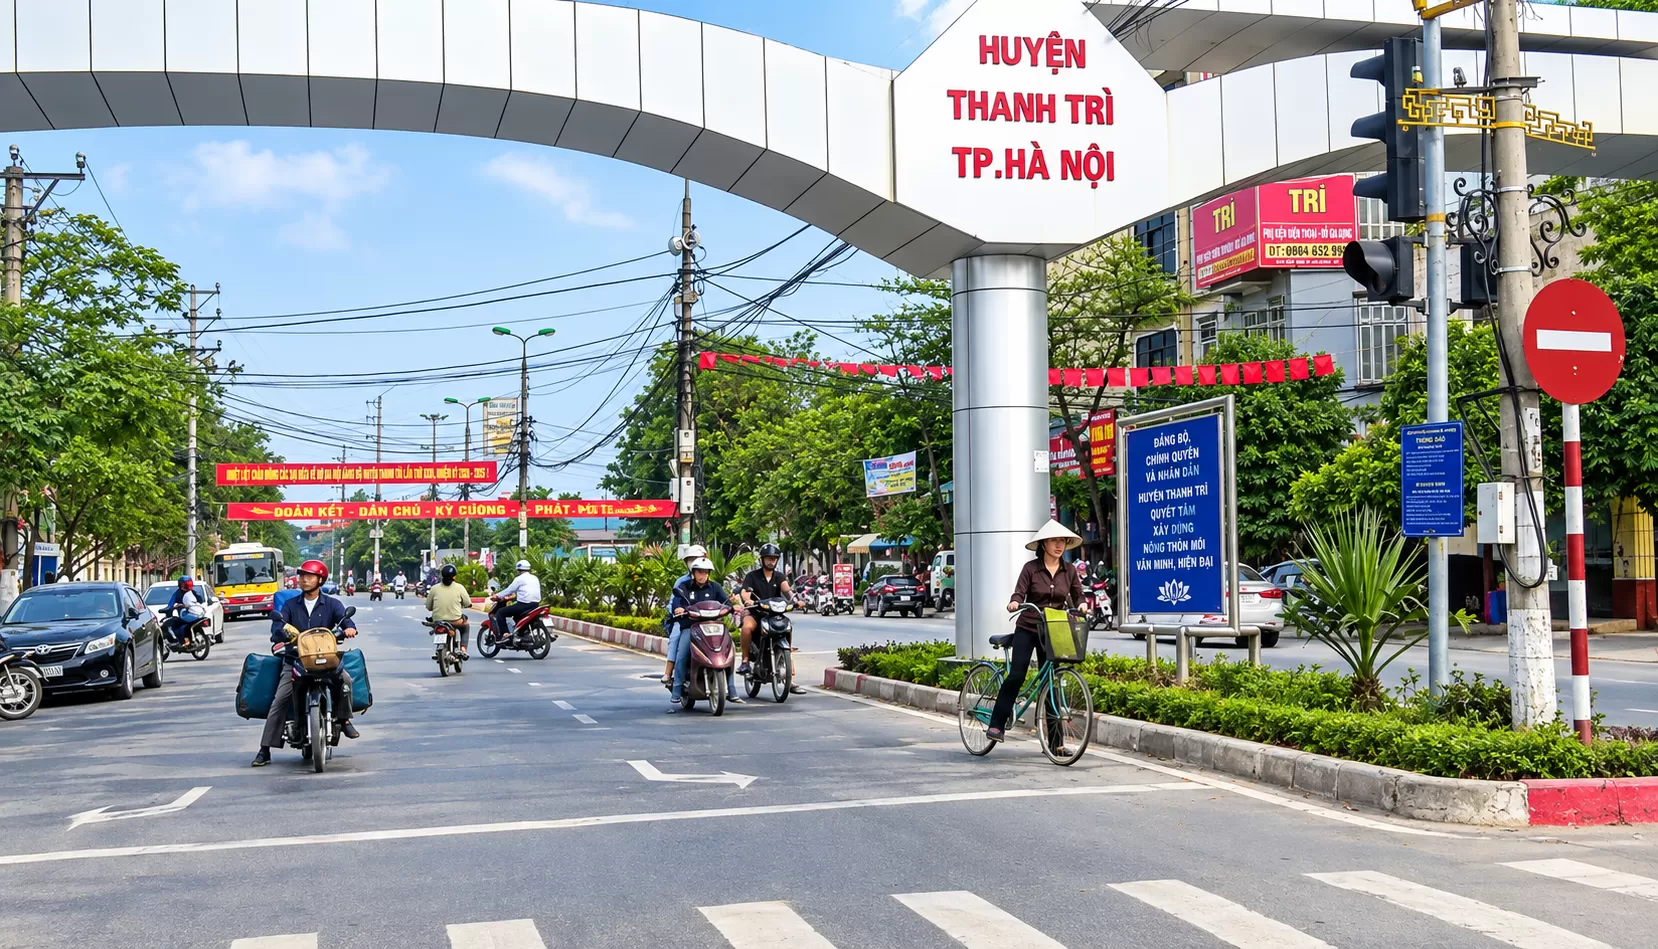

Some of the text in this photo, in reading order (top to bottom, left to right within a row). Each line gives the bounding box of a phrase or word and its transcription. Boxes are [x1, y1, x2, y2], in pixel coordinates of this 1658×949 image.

[979, 31, 1086, 75] HUYỆN
[947, 87, 1114, 125] THANH TRÌ
[952, 140, 1115, 189] TP.HÀ NỘI
[1166, 486, 1193, 500] THANH
